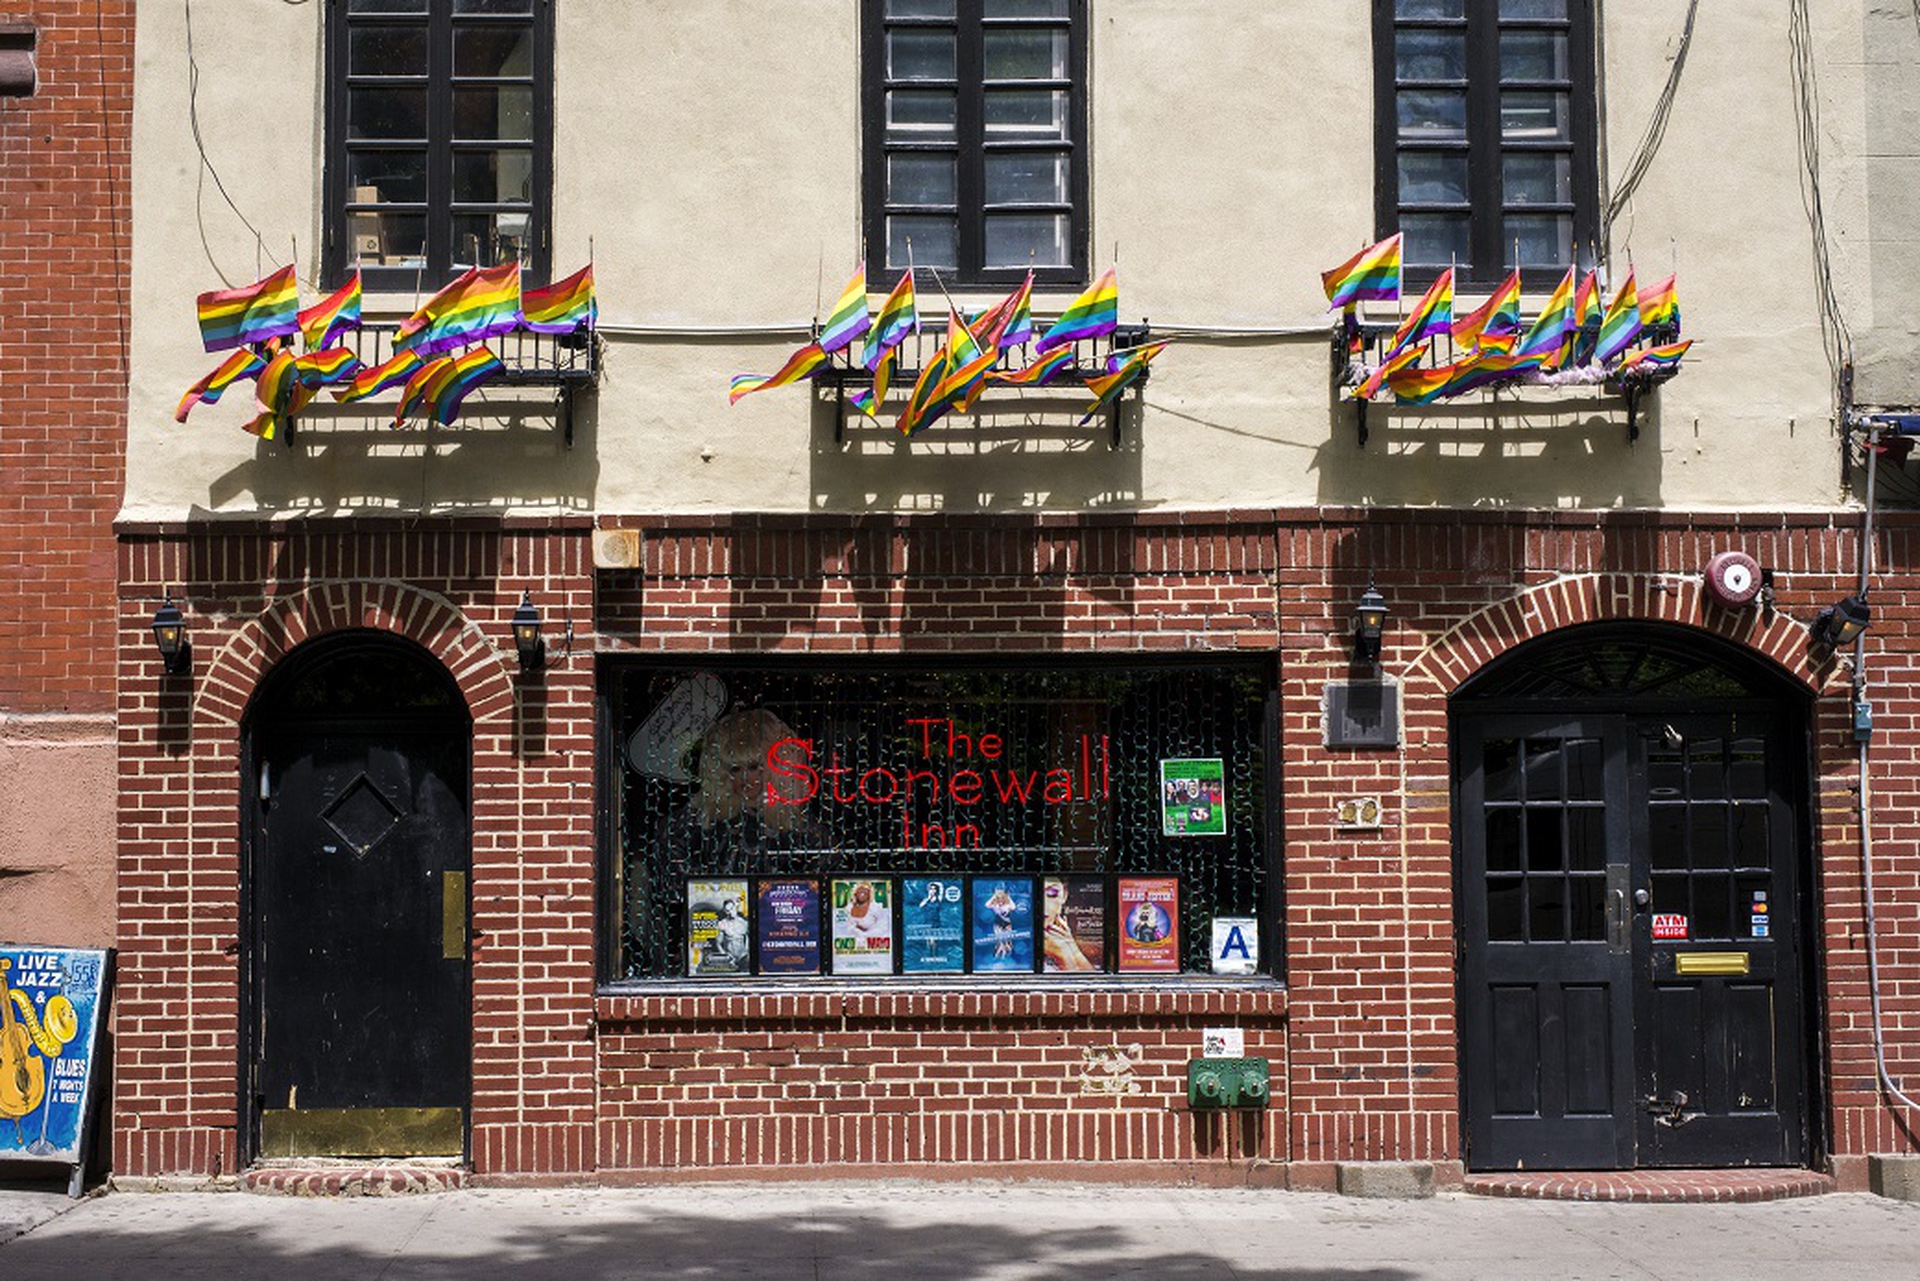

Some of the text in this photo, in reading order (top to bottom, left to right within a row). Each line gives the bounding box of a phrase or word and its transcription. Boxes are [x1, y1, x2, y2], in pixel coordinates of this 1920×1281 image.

[906, 719, 1004, 758] The
[766, 734, 1110, 807] Stonewall
[903, 810, 980, 850] Inn
[1655, 914, 1686, 926] ATM
[1220, 925, 1250, 959] A
[18, 954, 59, 970] LIVE
[16, 971, 62, 987] JAZZ
[35, 990, 46, 1004] &
[54, 1058, 86, 1077] BLUES
[51, 1092, 80, 1103] A WEEK
